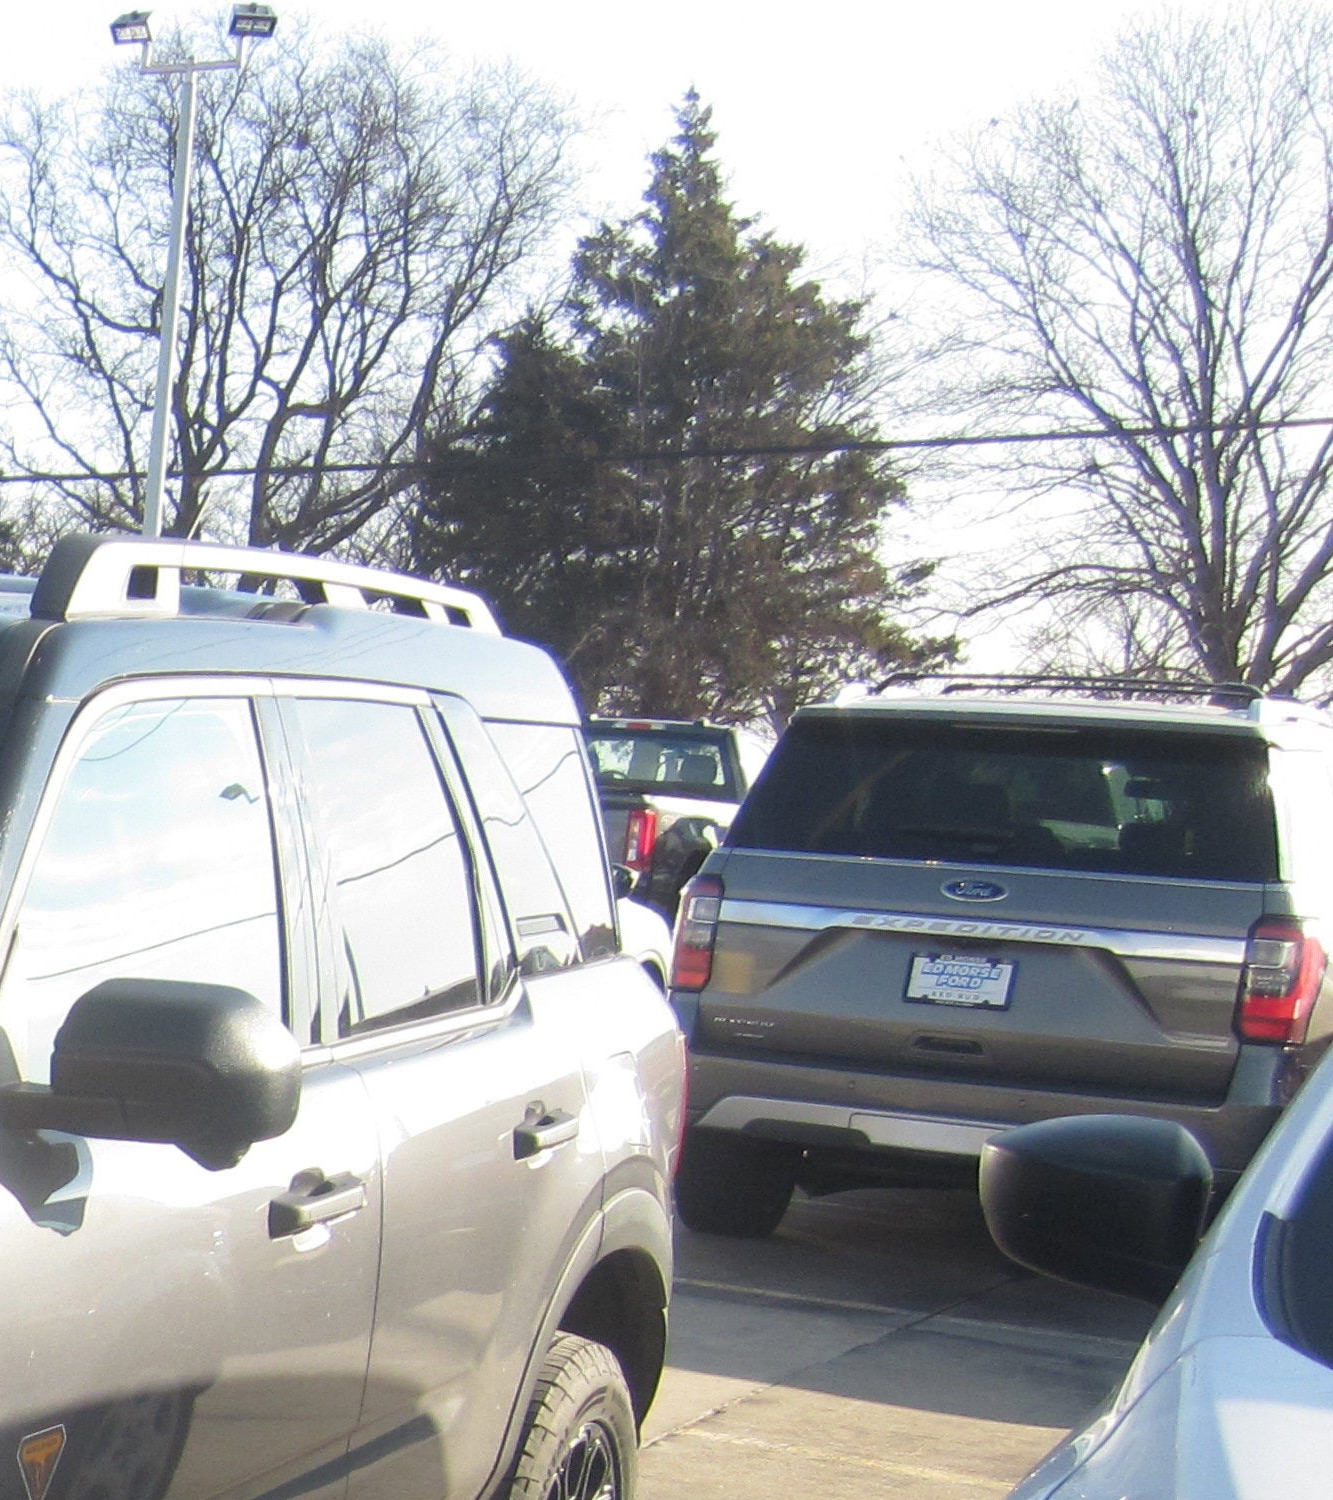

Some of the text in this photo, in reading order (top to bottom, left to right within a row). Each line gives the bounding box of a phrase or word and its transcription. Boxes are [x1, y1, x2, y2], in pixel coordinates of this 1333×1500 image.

[953, 881, 993, 899] Ford
[851, 914, 1085, 942] EXPEDITION
[922, 962, 1002, 980] ED MORSE
[935, 975, 983, 990] FORD
